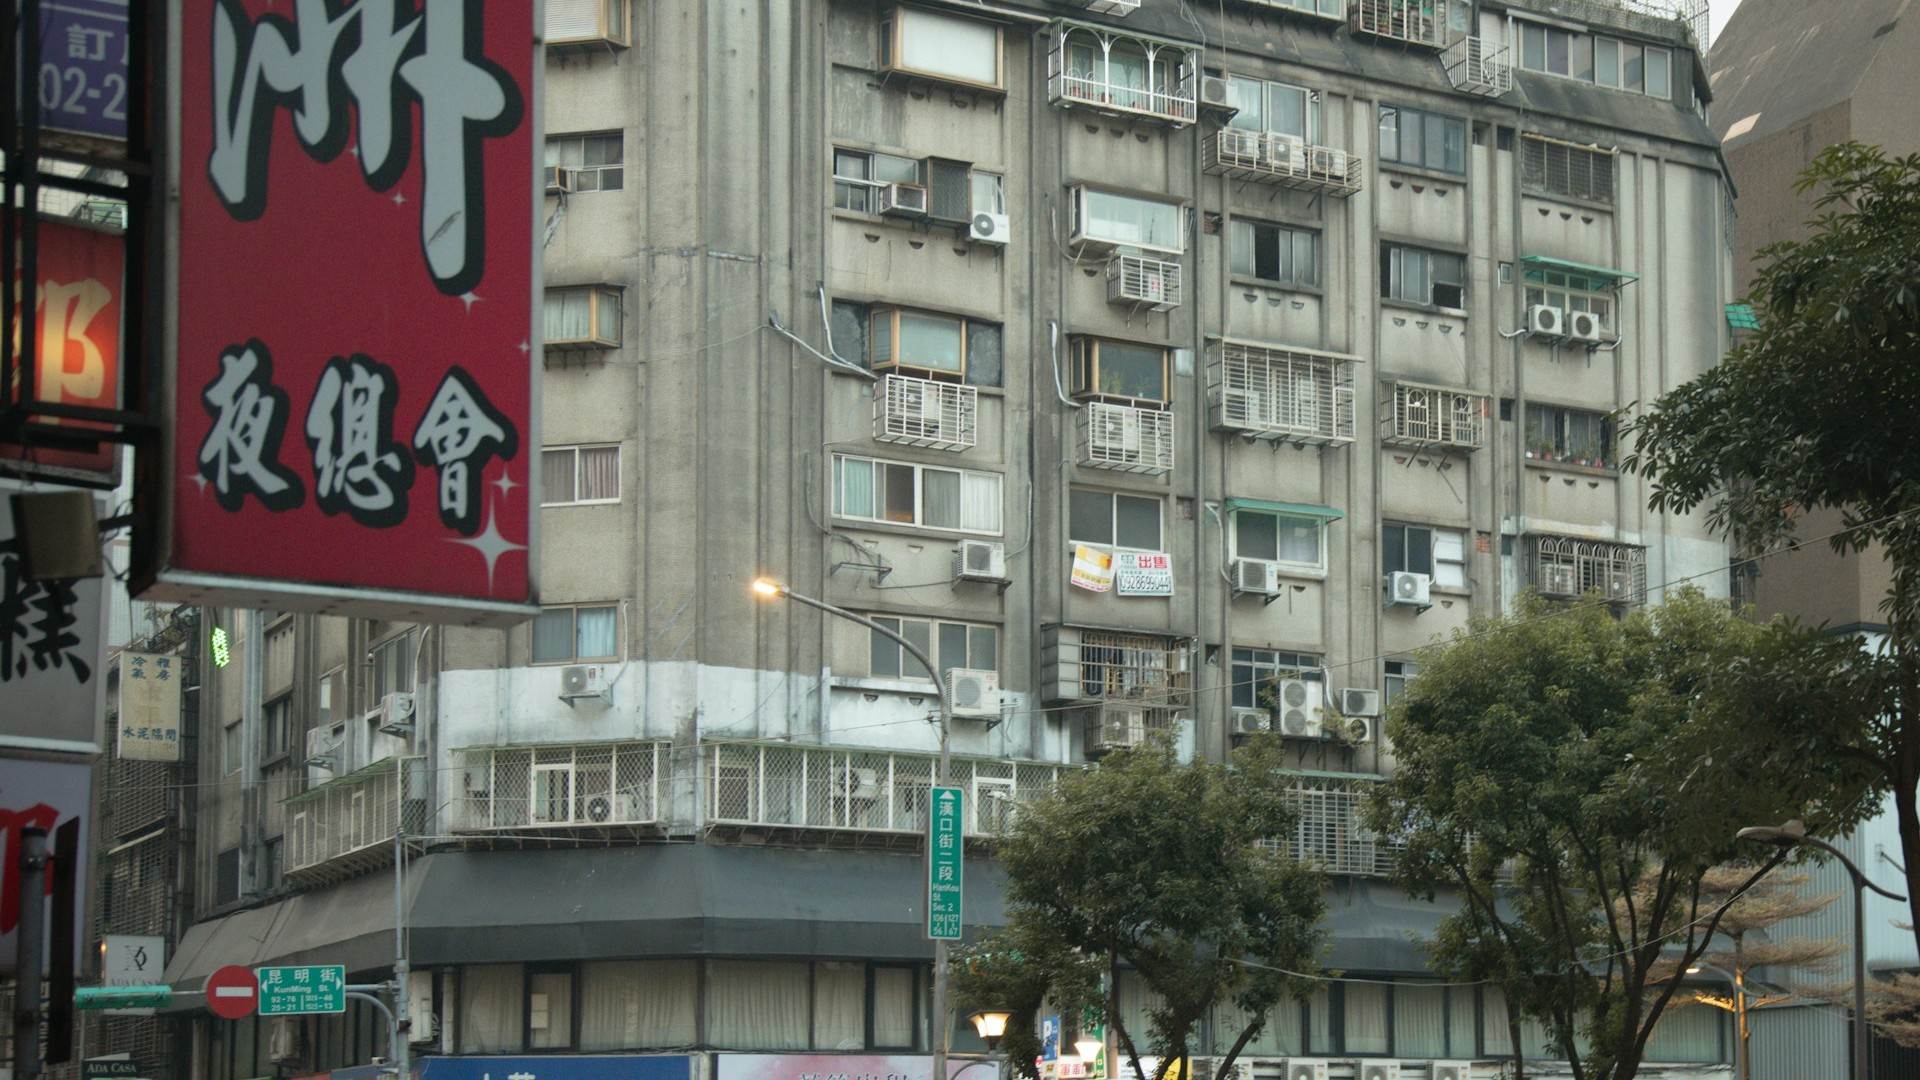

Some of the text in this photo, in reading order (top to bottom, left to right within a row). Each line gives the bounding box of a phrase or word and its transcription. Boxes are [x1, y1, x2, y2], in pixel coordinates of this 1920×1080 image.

[199, 343, 511, 525] 夜總會
[122, 726, 177, 742] 水泥隔間
[938, 801, 954, 881] 漢口街二段
[947, 902, 954, 912] 2
[268, 968, 336, 984] 昆明街
[273, 985, 312, 994] KunMing
[87, 1062, 137, 1073] ADA CASA
